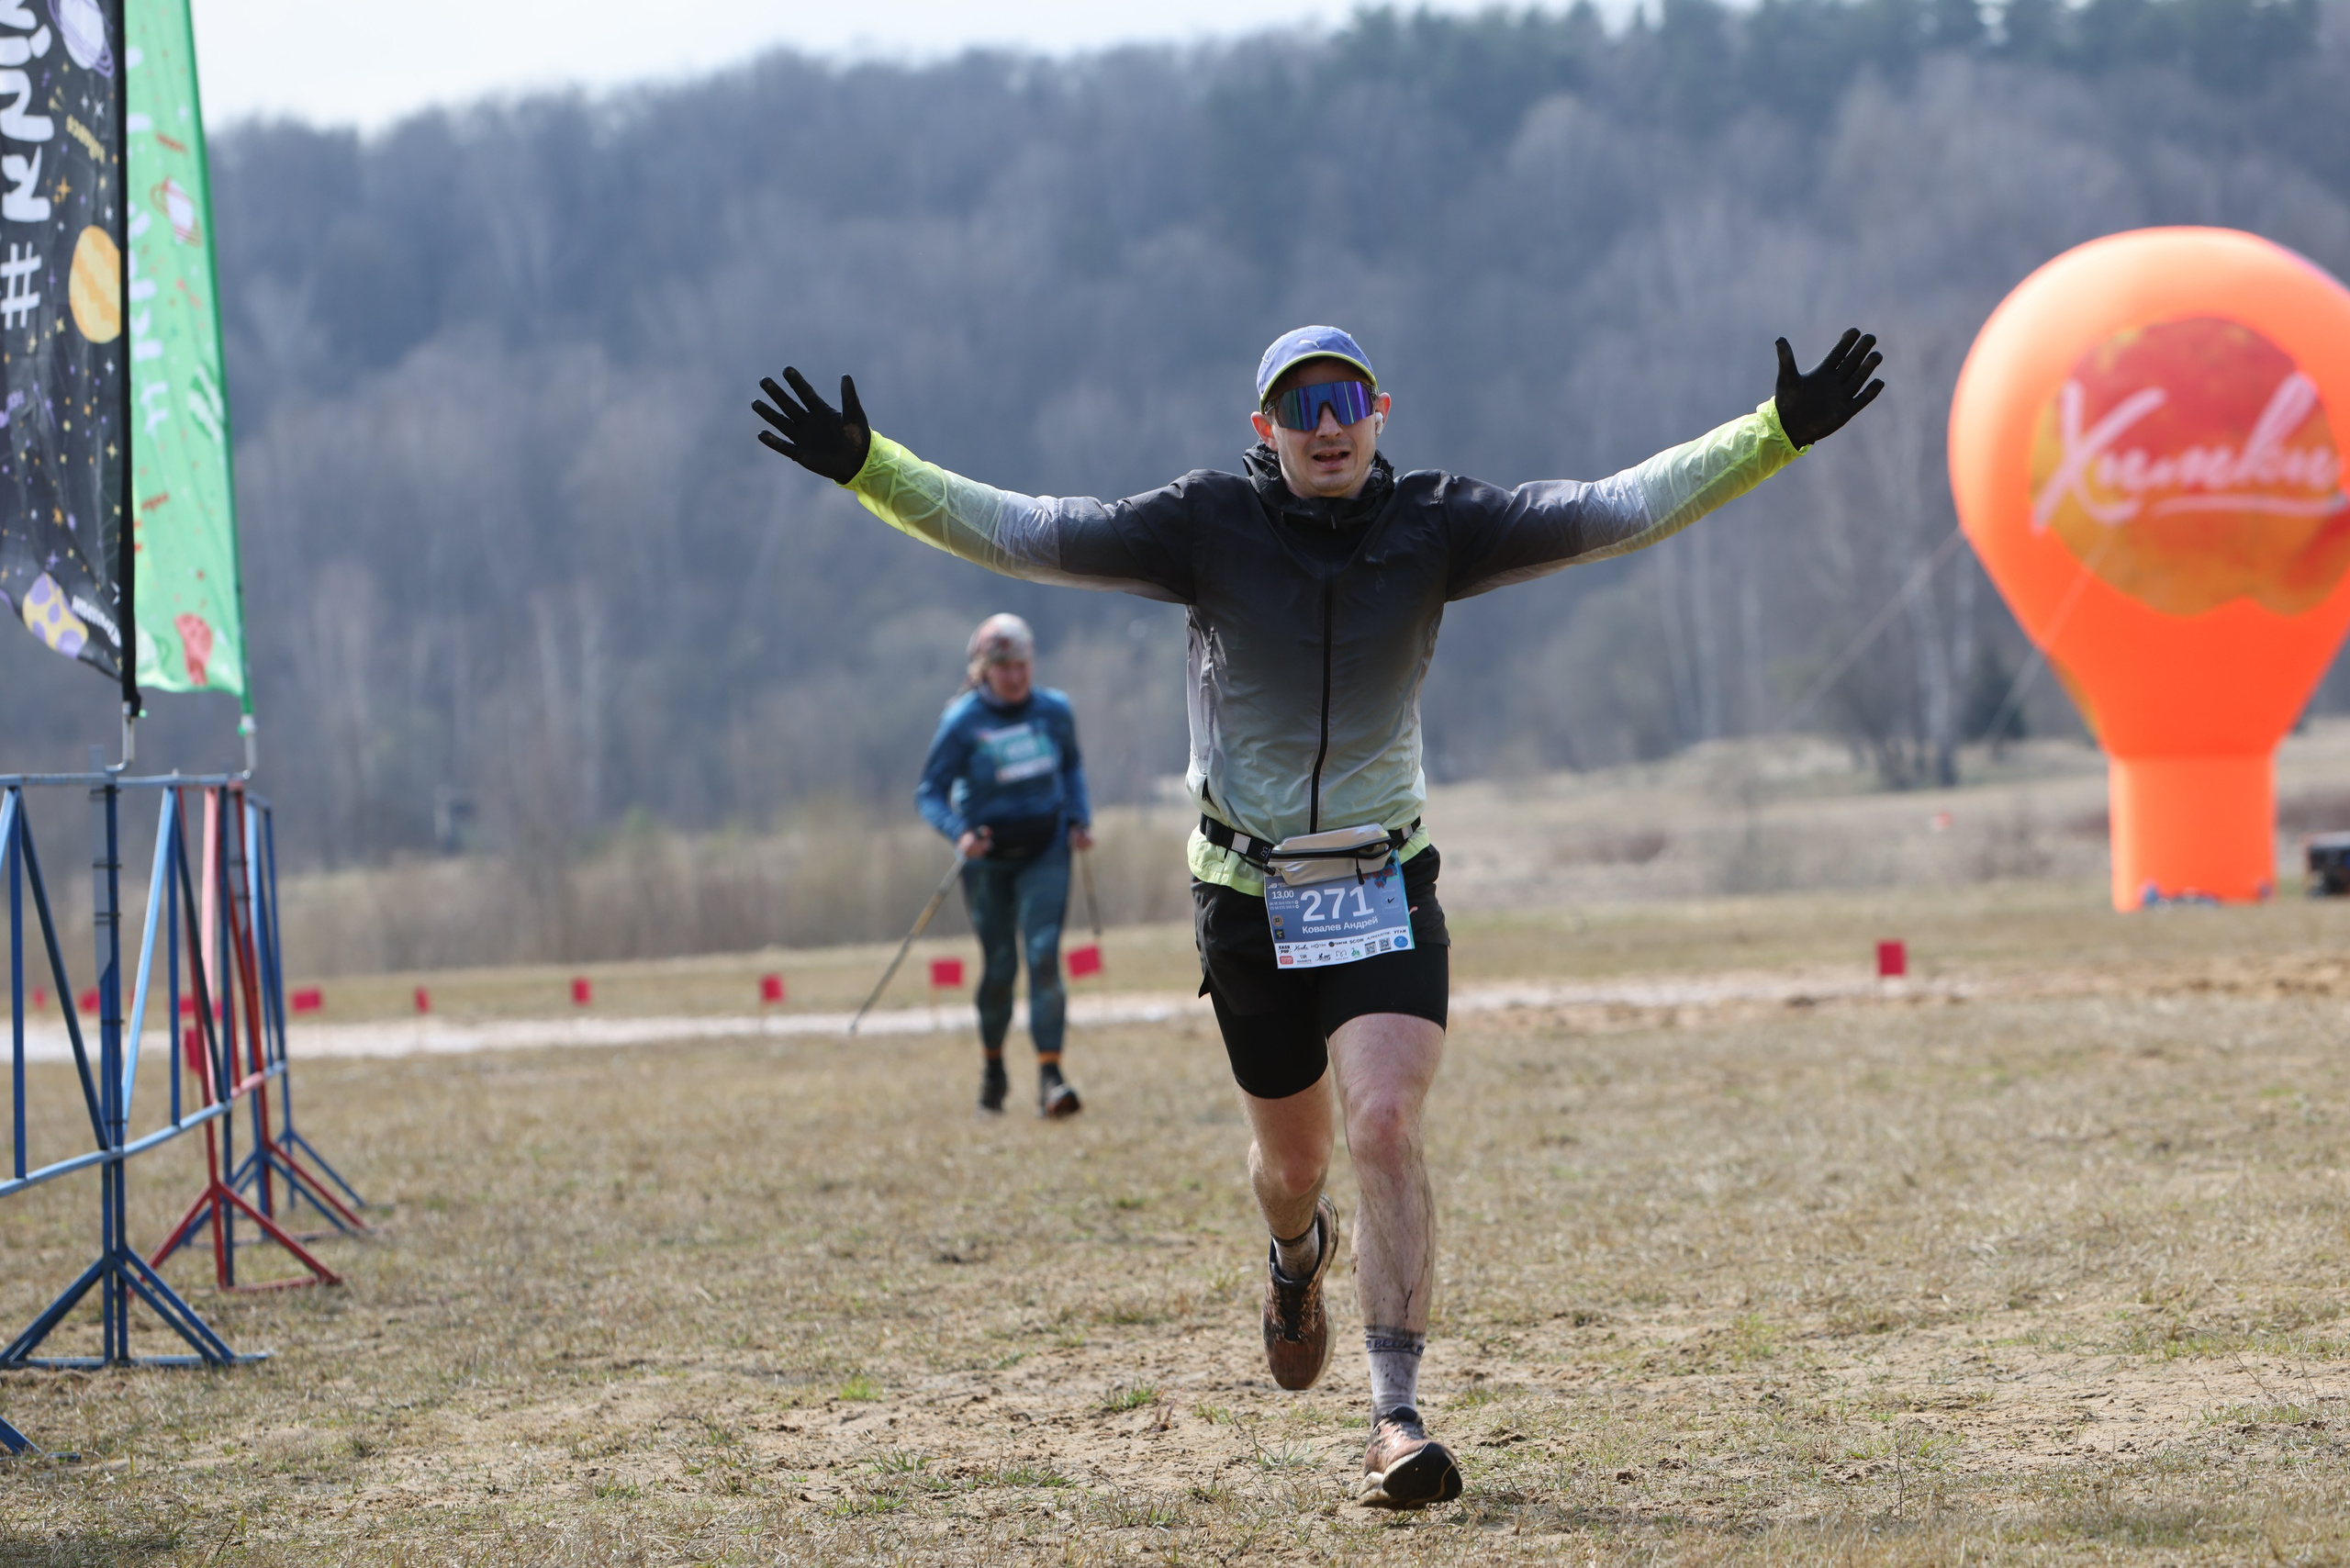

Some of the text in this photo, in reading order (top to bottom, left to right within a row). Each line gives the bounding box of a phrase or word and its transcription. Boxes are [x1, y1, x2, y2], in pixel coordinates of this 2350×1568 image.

[1271, 890, 1294, 900] 13,00
[1300, 886, 1374, 923] 271
[1302, 916, 1379, 935] Ковалев Андрей
